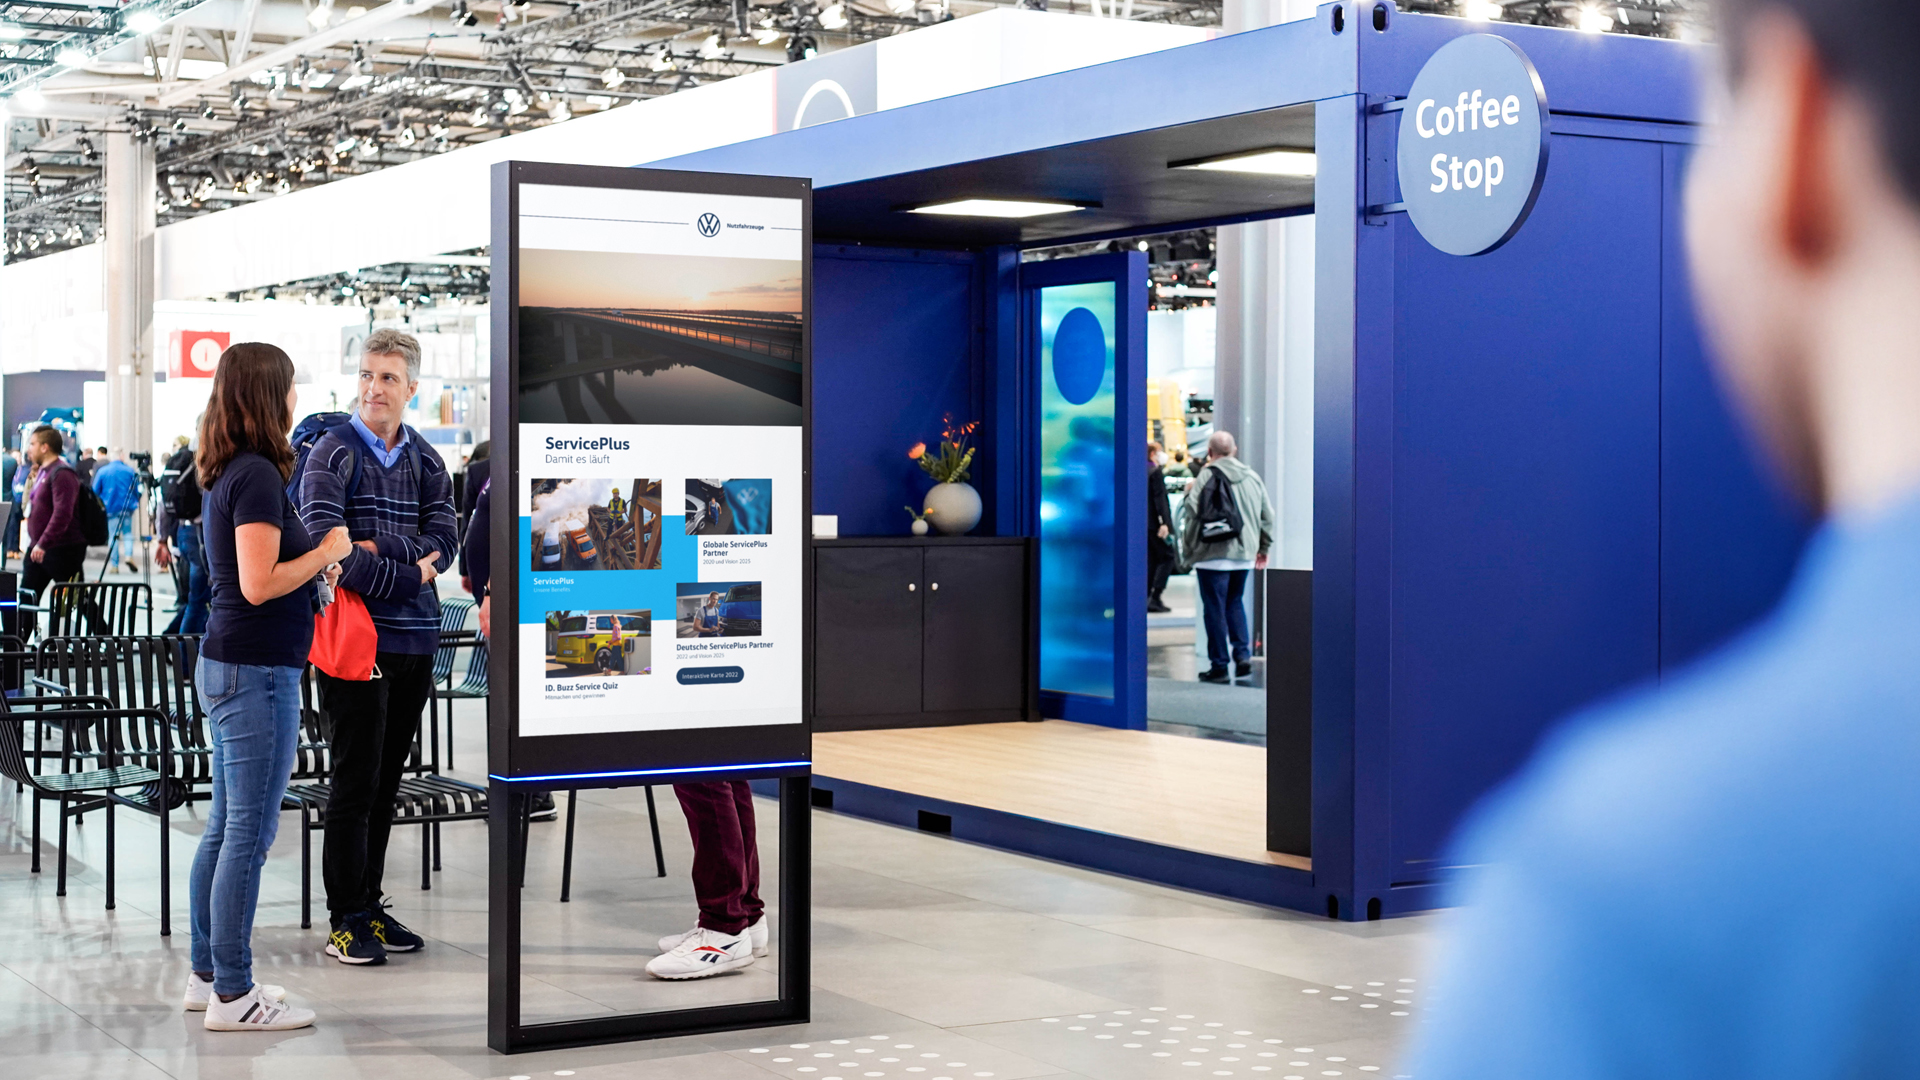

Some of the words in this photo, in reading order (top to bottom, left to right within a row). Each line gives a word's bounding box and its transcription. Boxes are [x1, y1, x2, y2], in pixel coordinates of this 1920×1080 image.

[1416, 89, 1520, 139] Coffee
[1430, 153, 1504, 197] Stop
[726, 223, 765, 231] Nutzfahrzeuge
[545, 436, 630, 450] ServicePlus
[545, 454, 574, 464] Damit
[575, 456, 587, 464] es
[589, 454, 610, 464] läuft
[730, 540, 768, 548] ServicePlus
[533, 577, 575, 586] ServicePlus
[676, 643, 708, 651] Deutsche
[709, 642, 748, 650] ServicePlus
[748, 641, 774, 649] Partner
[545, 684, 556, 692] ID.
[556, 684, 574, 692] Buzz
[575, 682, 601, 691] Service
[602, 681, 619, 690] Quiz
